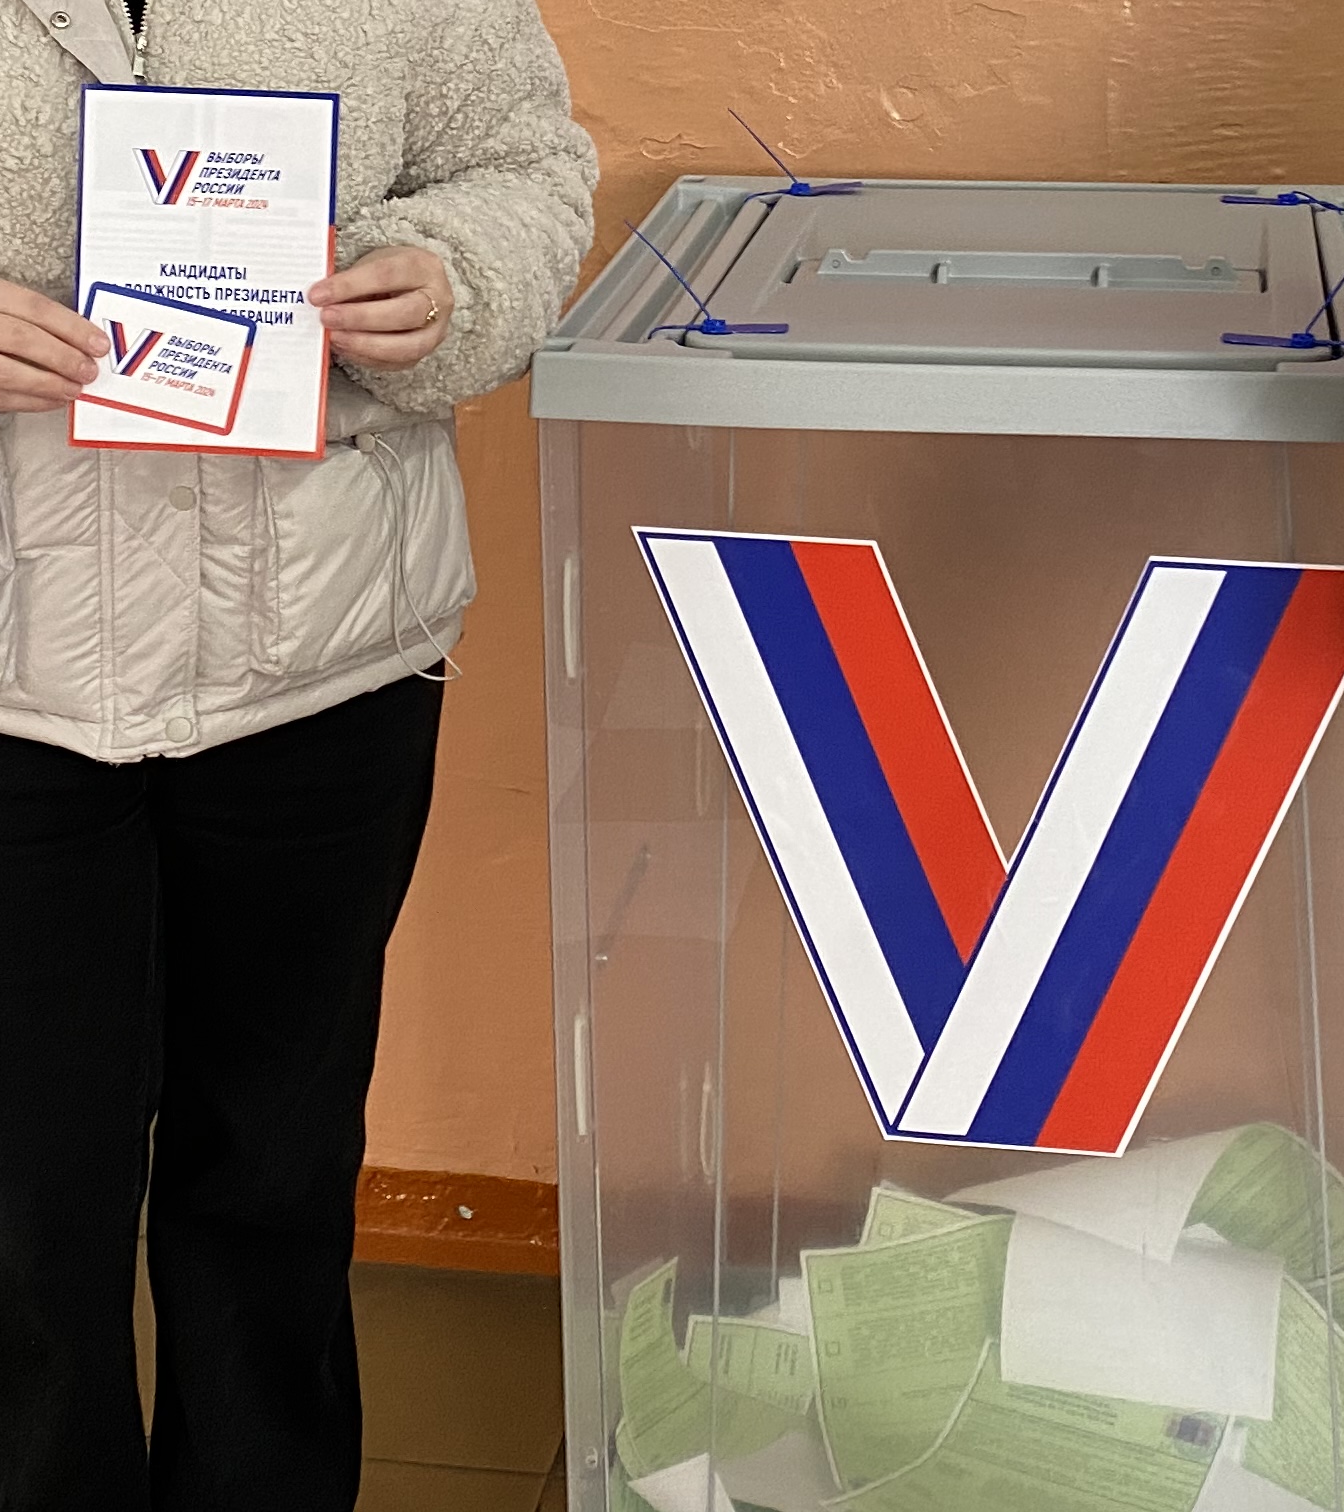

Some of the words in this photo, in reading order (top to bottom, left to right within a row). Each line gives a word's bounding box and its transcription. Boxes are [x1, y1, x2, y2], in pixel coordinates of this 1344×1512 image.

[207, 152, 265, 165] ВЫБОРЫ
[199, 167, 281, 181] ПРЕЗИДЕНТА
[192, 182, 245, 194] РОССИИ
[159, 263, 247, 280] КАНДИДАТЫ
[215, 287, 305, 305] ПРЕЗИДЕНТА
[167, 335, 221, 356] ВЫБОРЫ
[157, 348, 233, 374] ПРЕЗИДЕНТА
[148, 360, 198, 380] РОССИИ
